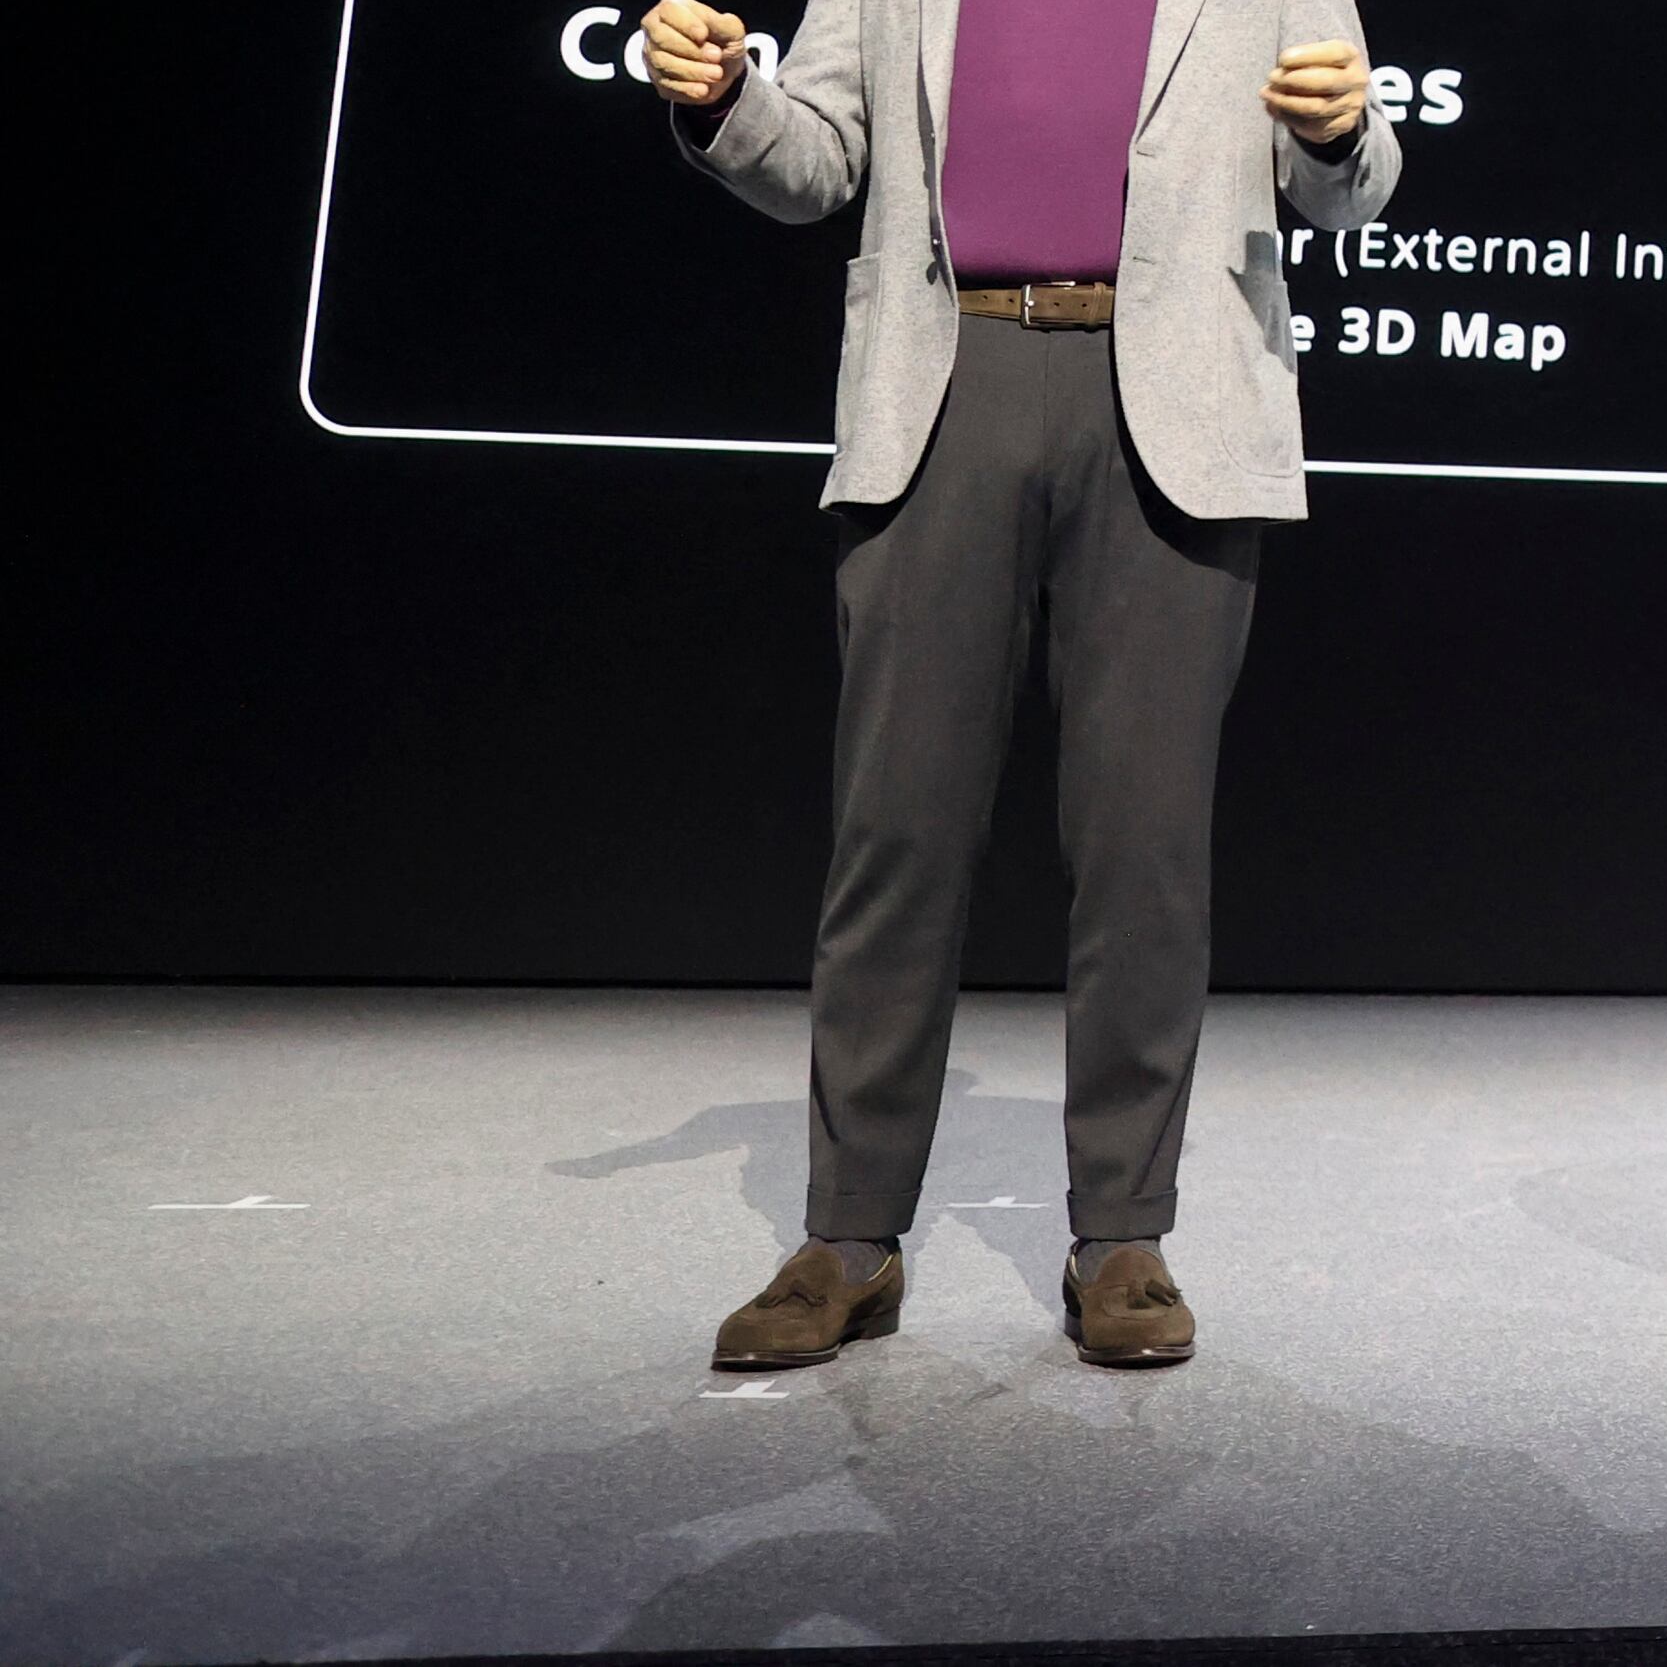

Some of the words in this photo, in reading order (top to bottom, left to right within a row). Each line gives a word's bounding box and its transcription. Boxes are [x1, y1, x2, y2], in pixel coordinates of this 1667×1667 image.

[1334, 221, 1590, 278] (External
[1337, 306, 1416, 355] 3D
[1440, 311, 1566, 372] Map
